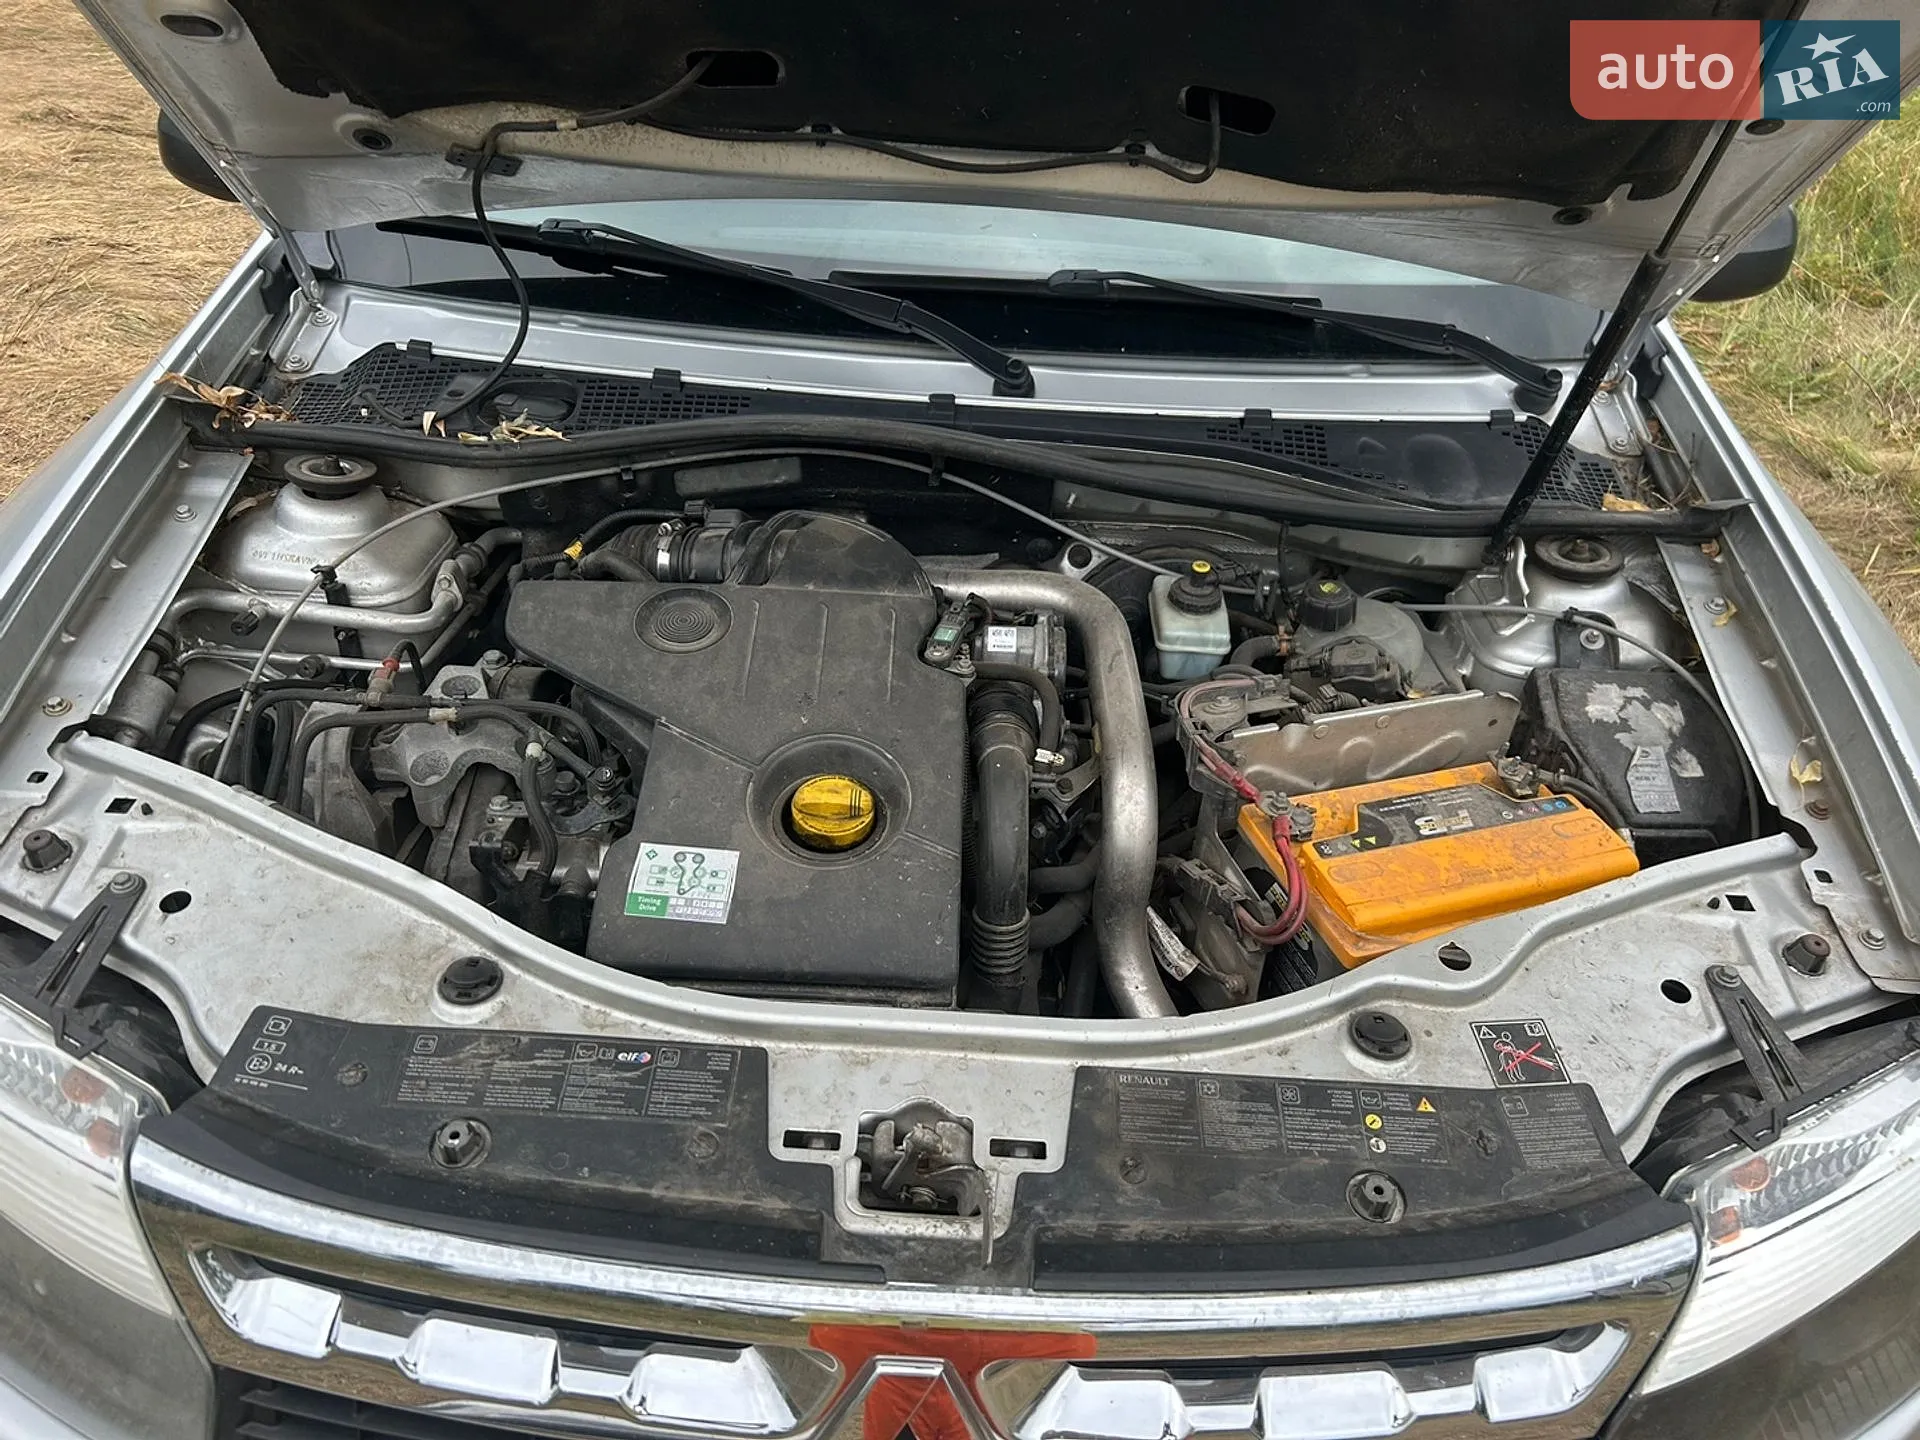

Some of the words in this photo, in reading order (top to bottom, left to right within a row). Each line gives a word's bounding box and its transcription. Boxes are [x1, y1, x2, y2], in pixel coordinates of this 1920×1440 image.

[637, 896, 661, 907] Timing
[638, 903, 657, 912] Drive
[617, 1051, 640, 1062] elf
[1119, 1074, 1169, 1087] RENAULT
